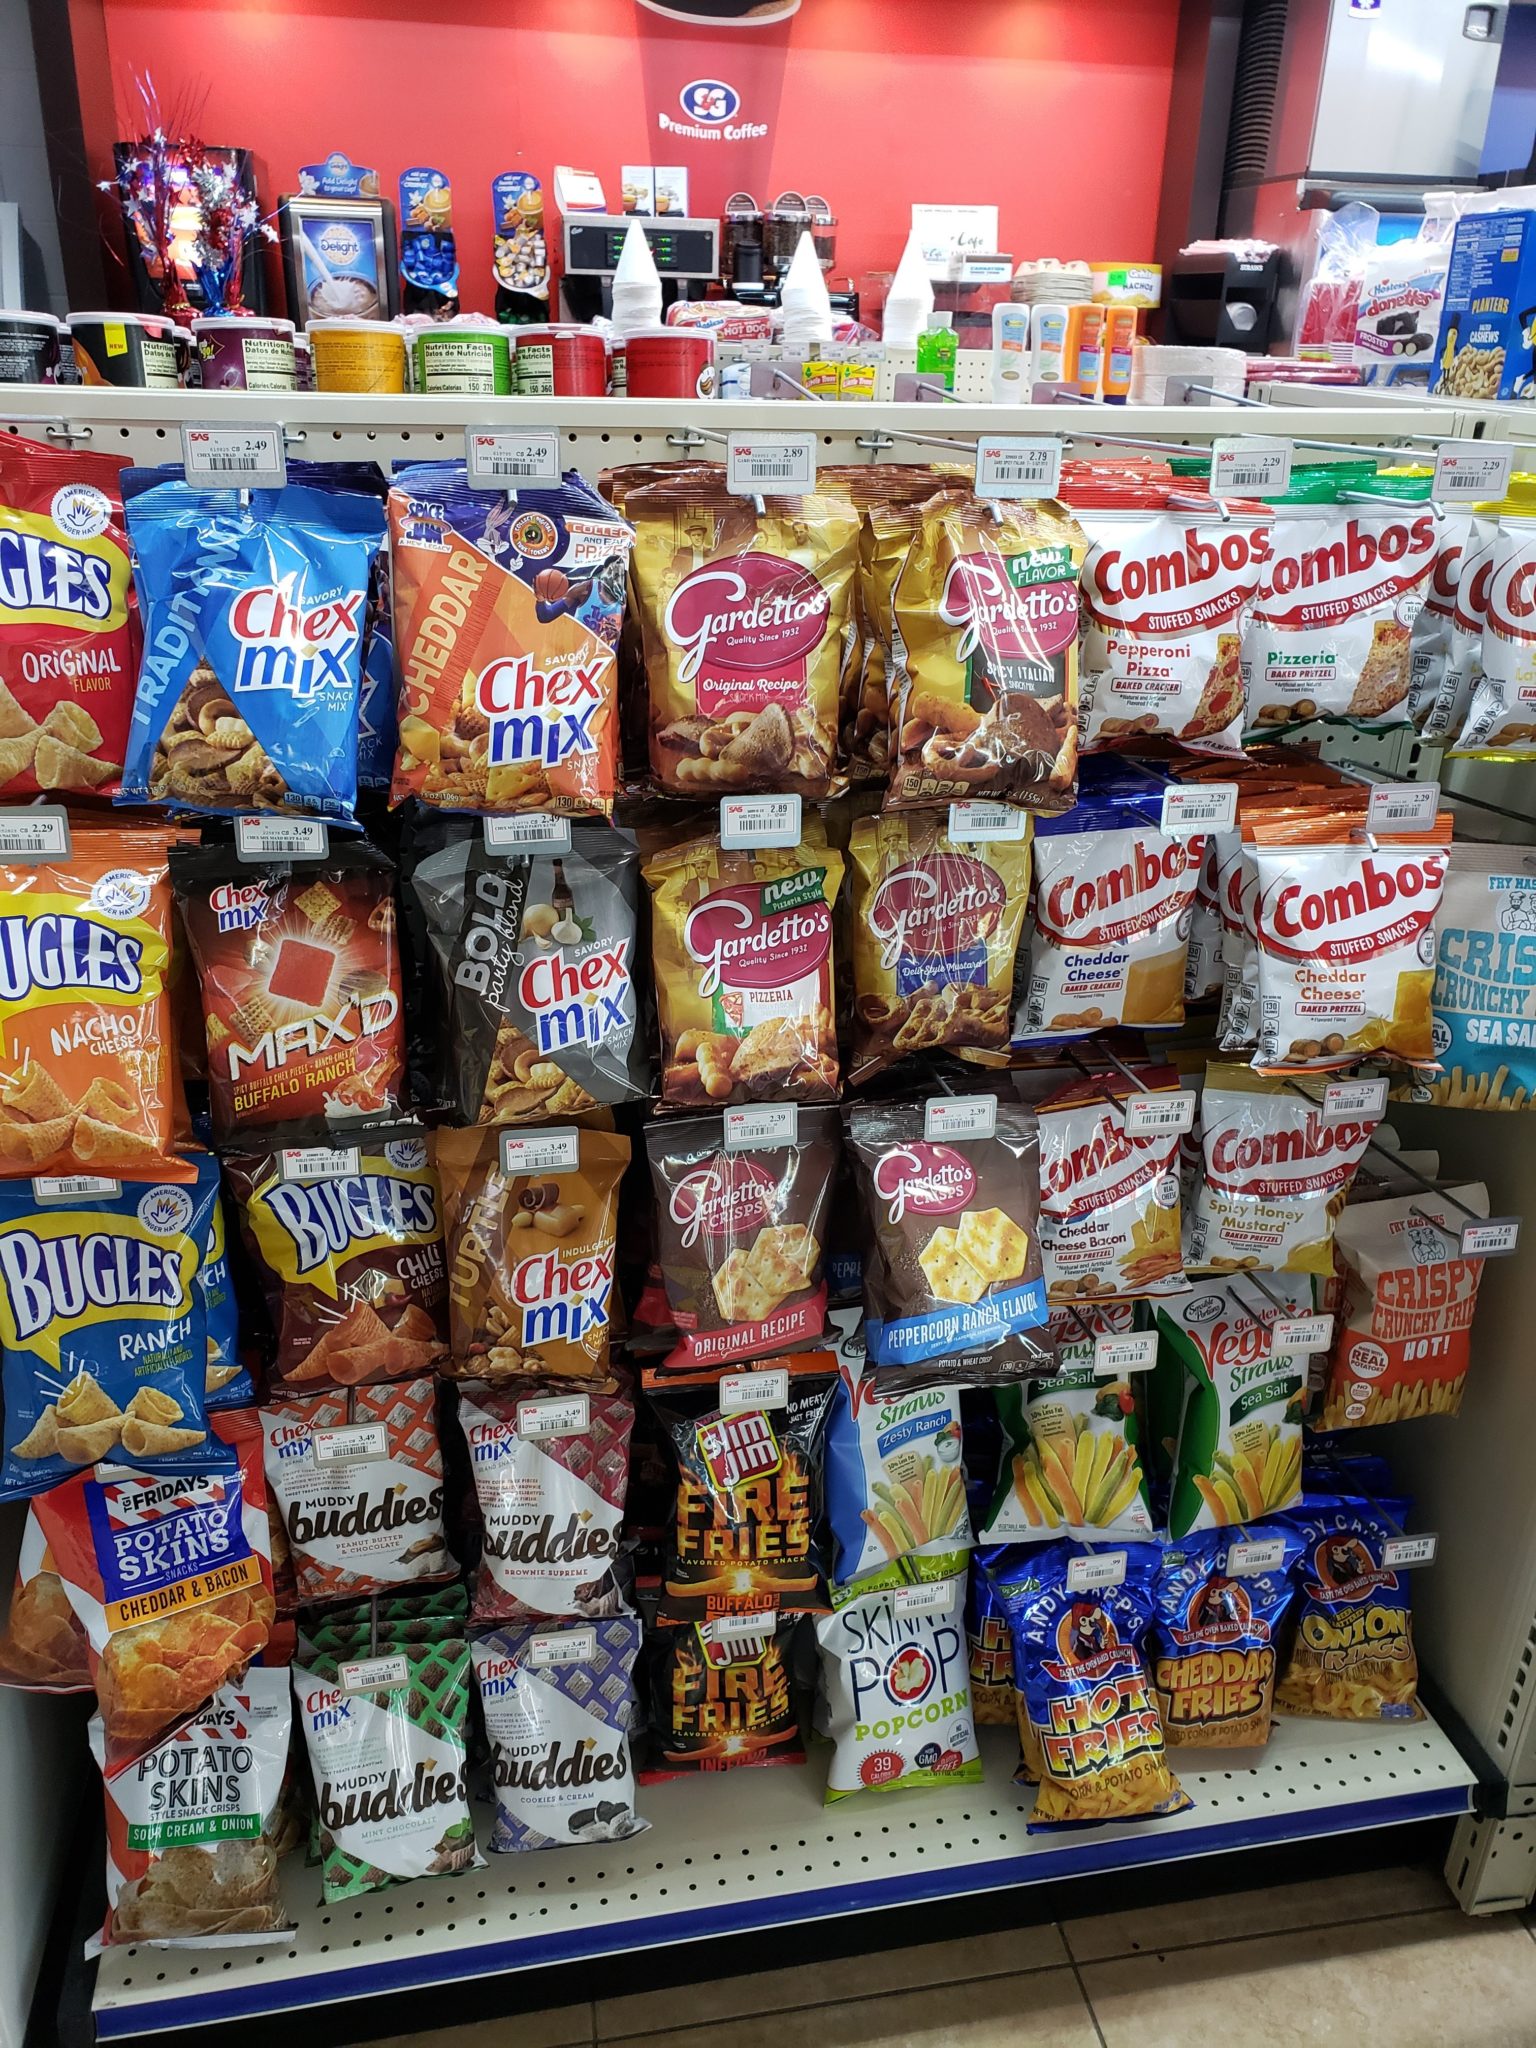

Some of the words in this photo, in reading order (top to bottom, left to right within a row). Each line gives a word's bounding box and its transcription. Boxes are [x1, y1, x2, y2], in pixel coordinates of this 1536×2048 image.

[658, 113, 721, 140] Premium
[724, 123, 768, 140] Coffee
[321, 239, 359, 256] Delight
[1373, 281, 1407, 296] Hostess
[1368, 290, 1432, 317] donettes
[1472, 298, 1510, 314] PLANTERS
[245, 340, 284, 348] Nutrition
[1360, 332, 1389, 349] FROSTED
[1470, 331, 1500, 344] CASHEWS
[468, 383, 480, 392] 150
[482, 382, 494, 392] 370
[530, 385, 539, 393] 150
[540, 385, 552, 393] 360
[245, 440, 267, 451] 2.49
[526, 447, 547, 457] 2.49
[783, 448, 803, 457] 2.89
[1029, 451, 1047, 461] 2.79
[1262, 458, 1280, 467] 2.29
[1482, 461, 1500, 470] 2.29
[59, 517, 81, 534] FINGER
[82, 524, 98, 536] HAT
[1017, 565, 1067, 585] FLAVOR
[1094, 527, 1270, 605] Combos
[233, 572, 363, 642] Chex
[297, 585, 344, 606] SAVORY
[1301, 597, 1349, 622] STUFFED
[1351, 580, 1398, 612] SNACKS
[938, 559, 1078, 663] Gardetto's
[1148, 609, 1192, 631] STUFFED
[1194, 591, 1241, 622] SNACKS
[403, 548, 489, 717] CHEDDAR
[665, 571, 828, 683] Gardetto's
[1039, 622, 1058, 633] 1932
[545, 650, 588, 666] SAVORY
[1106, 640, 1191, 659] Pepperoni
[240, 636, 355, 698] mix
[73, 676, 112, 693] FLAVOR
[478, 655, 604, 714] Chex
[702, 677, 754, 693] Original
[757, 678, 801, 695] Recipe
[491, 704, 597, 764] mix
[770, 804, 788, 813] 2.89
[1414, 794, 1430, 802] 2.29
[32, 824, 53, 833] 2.29
[293, 826, 313, 835] 3.49
[541, 815, 561, 824] 2.49
[1047, 834, 1206, 928] Combos
[209, 881, 266, 910] Chex
[1273, 855, 1445, 939] Combos
[219, 906, 265, 932] mix
[491, 878, 524, 945] blend
[869, 871, 1001, 970] Gardetto's
[455, 872, 508, 993] BOLD
[1330, 934, 1375, 957] STUFFED
[1376, 916, 1419, 946] SNACKS
[686, 900, 830, 999] Gardetto's
[485, 946, 525, 1012] party
[521, 939, 630, 1009] Chex
[902, 962, 945, 978] Deli-Style
[946, 959, 983, 975] Mustard
[1294, 969, 1367, 984] Cheddar
[1300, 987, 1362, 1001] Cheese
[540, 983, 628, 1051] mix
[1300, 1004, 1328, 1014] BAKED
[1329, 1003, 1363, 1014] PRETZEL
[51, 1015, 137, 1056] NACHO
[607, 1026, 633, 1047] SNACK
[234, 1079, 300, 1113] BUFFALO
[305, 1058, 357, 1090] RANCH
[969, 1108, 985, 1117] 2.39
[1170, 1101, 1185, 1109] 2.89
[769, 1114, 786, 1123] 2.39
[330, 1148, 348, 1157] 2.29
[549, 1142, 567, 1151] 3.49
[874, 1151, 973, 1225] Gardetto's
[1078, 1193, 1116, 1213] STUFFED
[1117, 1167, 1153, 1197] SNACKS
[1258, 1179, 1303, 1195] STUFFED
[1305, 1168, 1345, 1192] SNACKS
[669, 1170, 776, 1248] Gardetto's
[267, 1178, 436, 1274] BUGLES
[1058, 1221, 1110, 1239] Cheddar
[1041, 1237, 1087, 1252] Cheese
[1089, 1233, 1126, 1249] Bacon
[1, 1231, 183, 1341] BUGLES
[410, 1267, 445, 1289] CHEESE
[515, 1243, 614, 1304] Chex
[1376, 1257, 1485, 1308] CRISPY
[524, 1284, 609, 1346] mix
[888, 1315, 960, 1349] PEPPERCORN
[963, 1303, 1001, 1333] RANCH
[1003, 1291, 1037, 1321] FLAVOR
[118, 1317, 192, 1361] RANCH
[694, 1322, 757, 1356] ORIGINAL
[760, 1310, 806, 1338] RECIPE
[1403, 1335, 1450, 1362] HOT!
[763, 1378, 779, 1387] 2.29
[564, 1408, 581, 1417] 3.49
[875, 1390, 946, 1432] Straws
[358, 1433, 375, 1443] 3.49
[882, 1427, 913, 1449] Zesty
[914, 1414, 948, 1437] Ranch
[305, 1495, 355, 1510] MUDDY
[488, 1514, 540, 1527] MUDDY
[114, 1510, 228, 1558] POTATO
[677, 1521, 810, 1562] FRIES
[118, 1529, 230, 1580] SKINS
[930, 1585, 944, 1593] 1.59
[706, 1593, 773, 1611] BUFFALO
[570, 1640, 587, 1649] 3.49
[1324, 1634, 1410, 1673] RINGS
[384, 1662, 401, 1671] 3.49
[476, 1655, 519, 1683] Chex
[1156, 1650, 1273, 1688] CHEDDAR
[672, 1662, 789, 1703] FIRE
[671, 1686, 790, 1731] FRIES
[1170, 1683, 1263, 1721] FRIES
[855, 1690, 970, 1743] POPCORN
[138, 1745, 253, 1782] POTATO
[874, 1756, 891, 1772] 39
[148, 1775, 241, 1811] SKINS
[336, 1770, 387, 1793] MUDDY
[149, 1808, 175, 1822] STYLE
[176, 1805, 208, 1818] SNACK
[209, 1802, 241, 1815] CRISPS
[133, 1821, 163, 1841] SOUR
[166, 1819, 207, 1839] CREAM
[209, 1819, 219, 1834] &
[221, 1816, 254, 1834] ONION
[361, 1829, 382, 1841] MINT
[384, 1816, 437, 1837] CHOCOLATE
